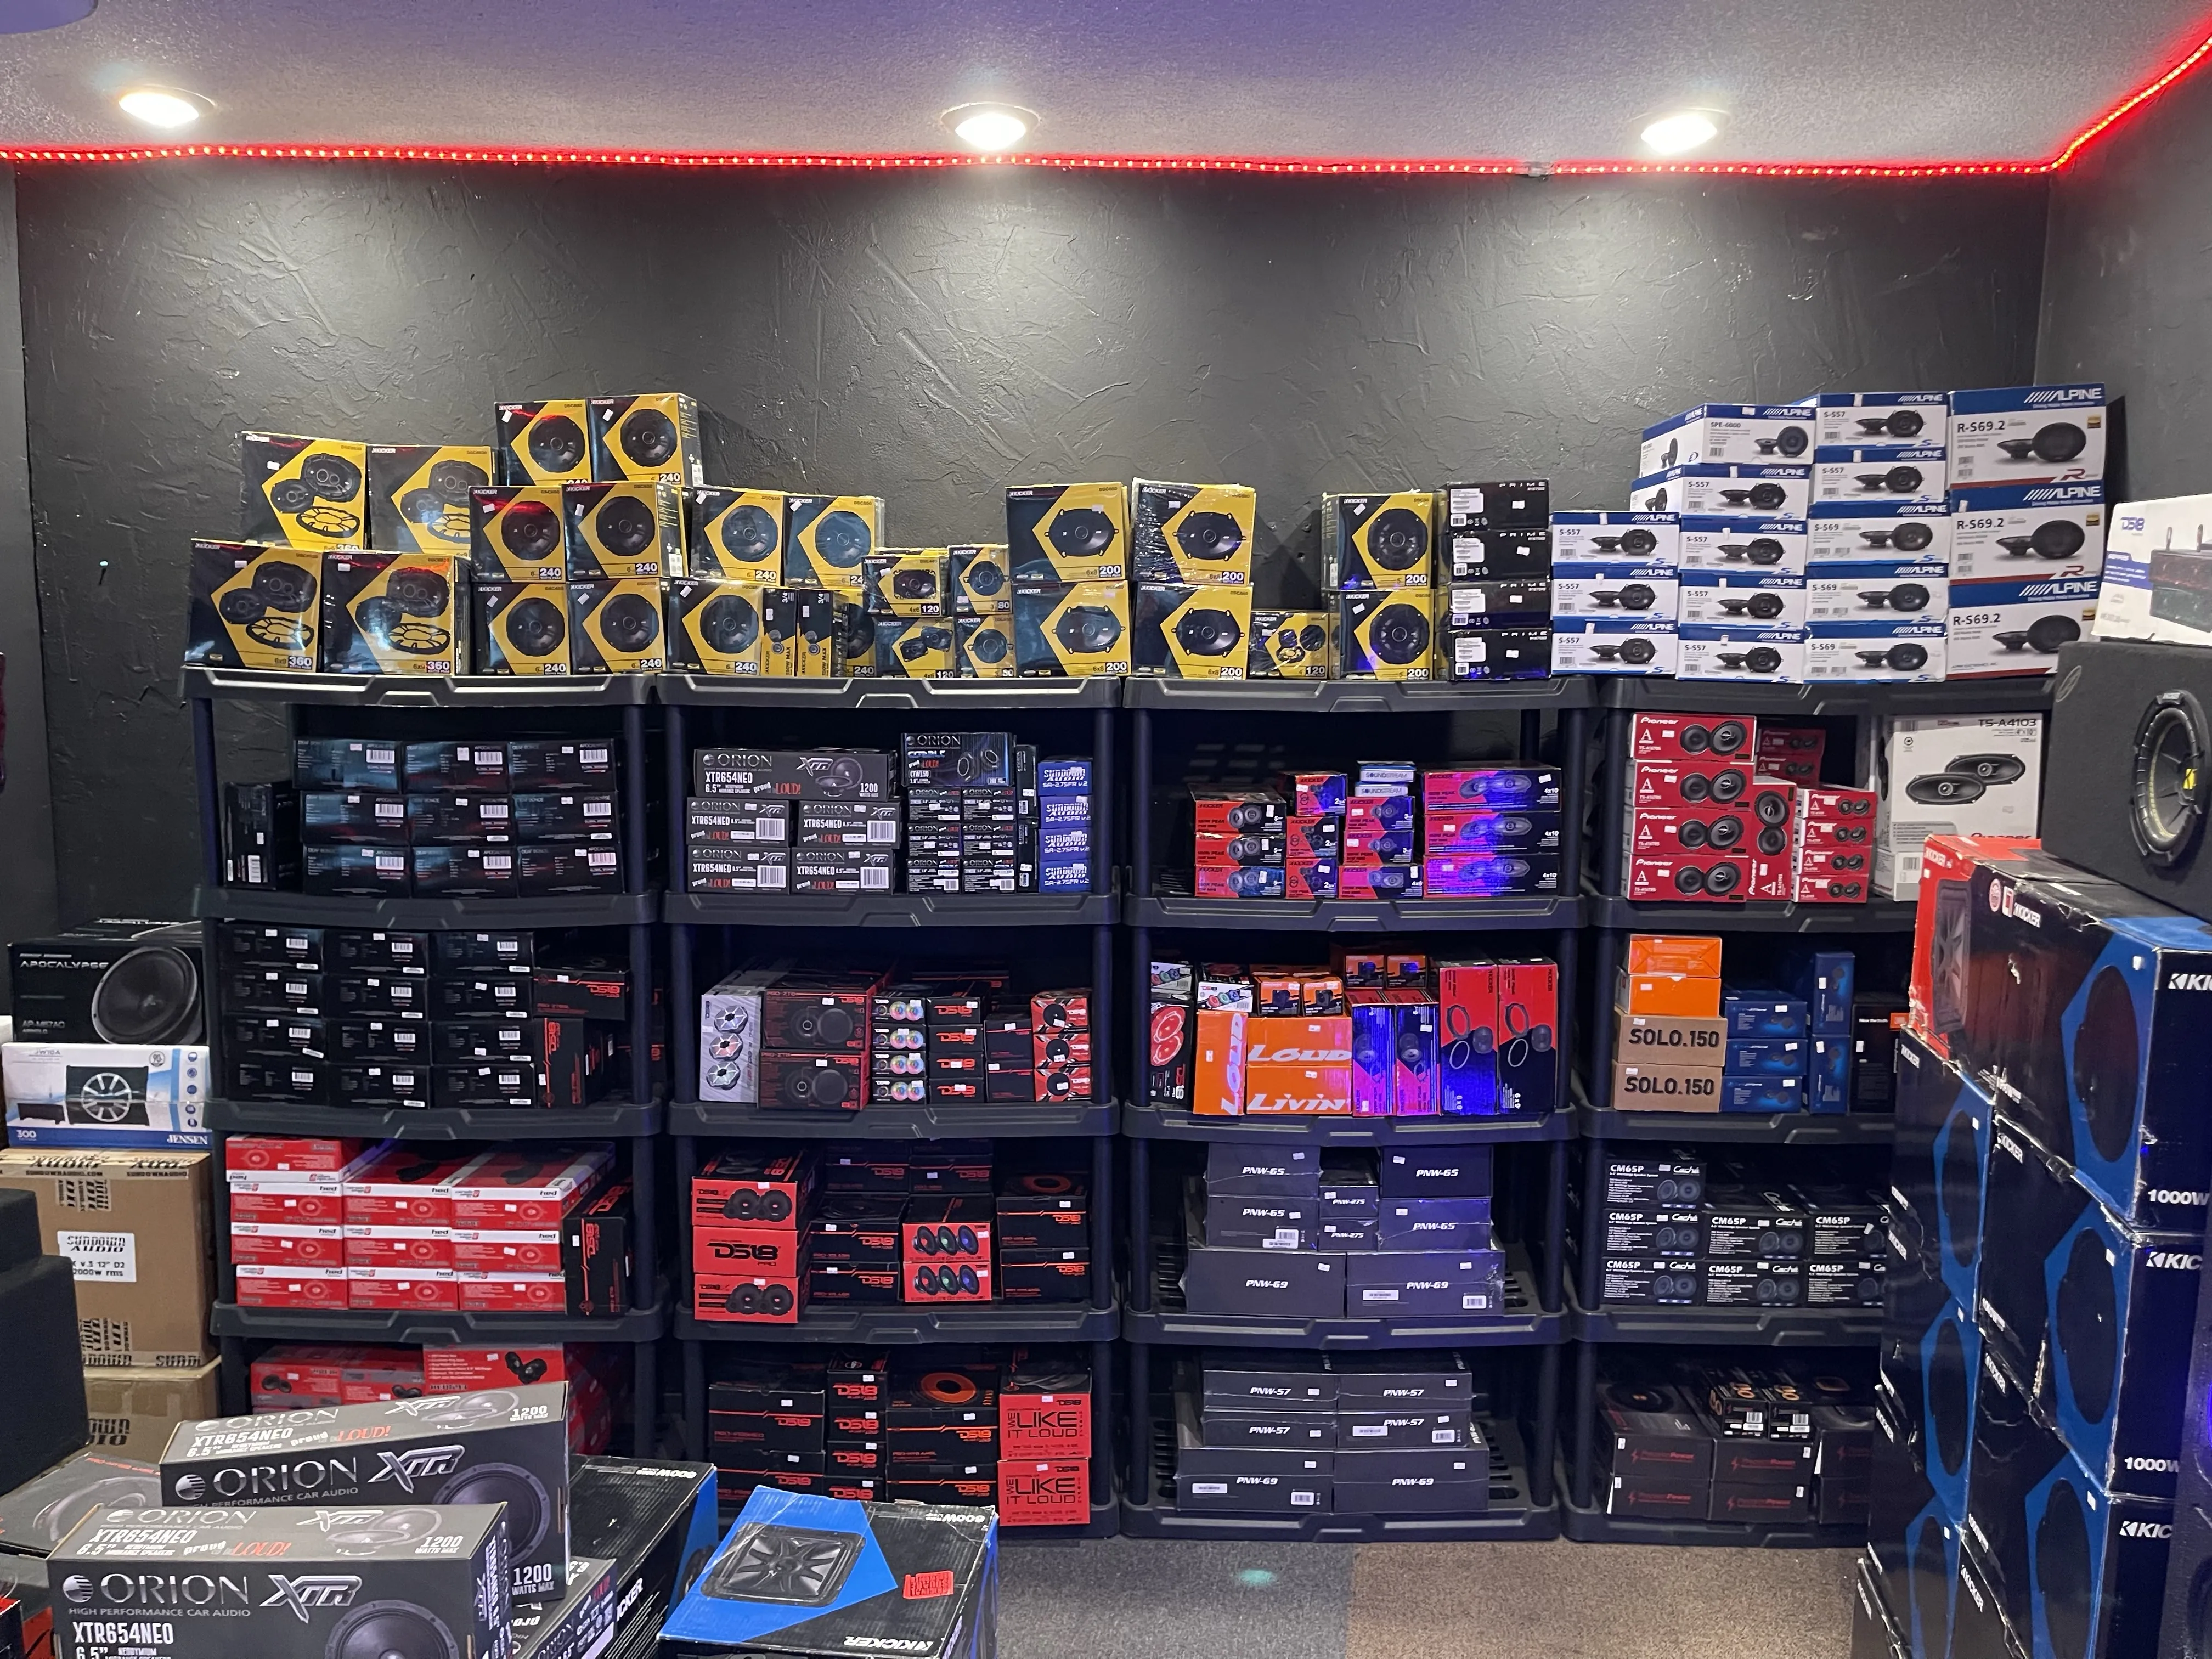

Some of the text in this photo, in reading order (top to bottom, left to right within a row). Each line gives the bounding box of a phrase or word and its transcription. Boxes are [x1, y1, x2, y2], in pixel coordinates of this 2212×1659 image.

[2024, 388, 2102, 403] ALPINE
[1957, 420, 2006, 433] R-S69.2
[659, 473, 680, 483] 240
[1897, 505, 1946, 514] ALPINE
[1957, 518, 2004, 530] R-S69.2
[755, 571, 777, 580] 240
[1099, 566, 1121, 575] 200
[851, 575, 863, 584] 24
[2019, 582, 2097, 596] ALPINE
[922, 605, 939, 614] 120
[998, 601, 1009, 610] 80
[1953, 613, 2001, 625] R-S69.2
[289, 657, 312, 668] 360
[427, 661, 450, 672] 360
[544, 664, 566, 673] 240
[854, 666, 874, 675] 240
[1221, 667, 1242, 676] 200
[1306, 665, 1325, 675] 120
[1407, 669, 1429, 678] 200
[1641, 716, 1679, 725] Pioneer
[1978, 719, 2036, 727] TS-A4103
[917, 735, 961, 746] ORION
[718, 753, 772, 767] ORION
[860, 783, 878, 792] 1200
[813, 804, 851, 814] ORION
[803, 819, 842, 829] XTR654NEO
[703, 849, 742, 859] ORION
[693, 864, 731, 873] XTR654NEO
[1628, 1028, 1719, 1048] SOLO.150
[1624, 1076, 1714, 1096] SOLO.150
[167, 1135, 208, 1144] JENSEN
[1242, 1166, 1285, 1176] PNW-65
[1610, 1164, 1644, 1172] CM65P
[2148, 1189, 2209, 1206] 1000W
[1413, 1222, 1455, 1231] PNW-65
[1712, 1217, 1746, 1226] CM65P
[67, 1236, 125, 1246] SUNDOWN
[706, 1242, 778, 1261] DS18
[1607, 1260, 1641, 1268] CM65P
[1245, 1279, 1288, 1289] PNW-69
[512, 1406, 547, 1417] 1200
[226, 1408, 339, 1429] ORION
[775, 1418, 811, 1426] DS18
[1017, 1412, 1077, 1428] LIKE
[192, 1427, 294, 1448] XTR654NEO
[338, 1426, 391, 1441] LOUD!
[1008, 1429, 1077, 1438] IT LOUD
[290, 1431, 328, 1447] proud
[832, 1453, 877, 1463] DS18
[1015, 1477, 1075, 1494] LIKE
[1392, 1478, 1434, 1486] PNW-69
[296, 1491, 319, 1500] CAR
[321, 1487, 358, 1498] AUDIO
[1006, 1495, 1076, 1504] IT LOUD
[137, 1509, 257, 1525] ORION
[944, 1513, 985, 1523] 600W
[88, 1530, 198, 1544] XTR654NEO
[183, 1541, 227, 1555] proud
[230, 1541, 292, 1556] LOUD!
[514, 1564, 552, 1585] 1200
[100, 1573, 249, 1605] ORION
[512, 1581, 555, 1595] WATTS MAX
[100, 1608, 183, 1616] PERFORMANCE
[72, 1622, 174, 1644] XTR654NEO
[843, 1636, 934, 1651] KICKER
